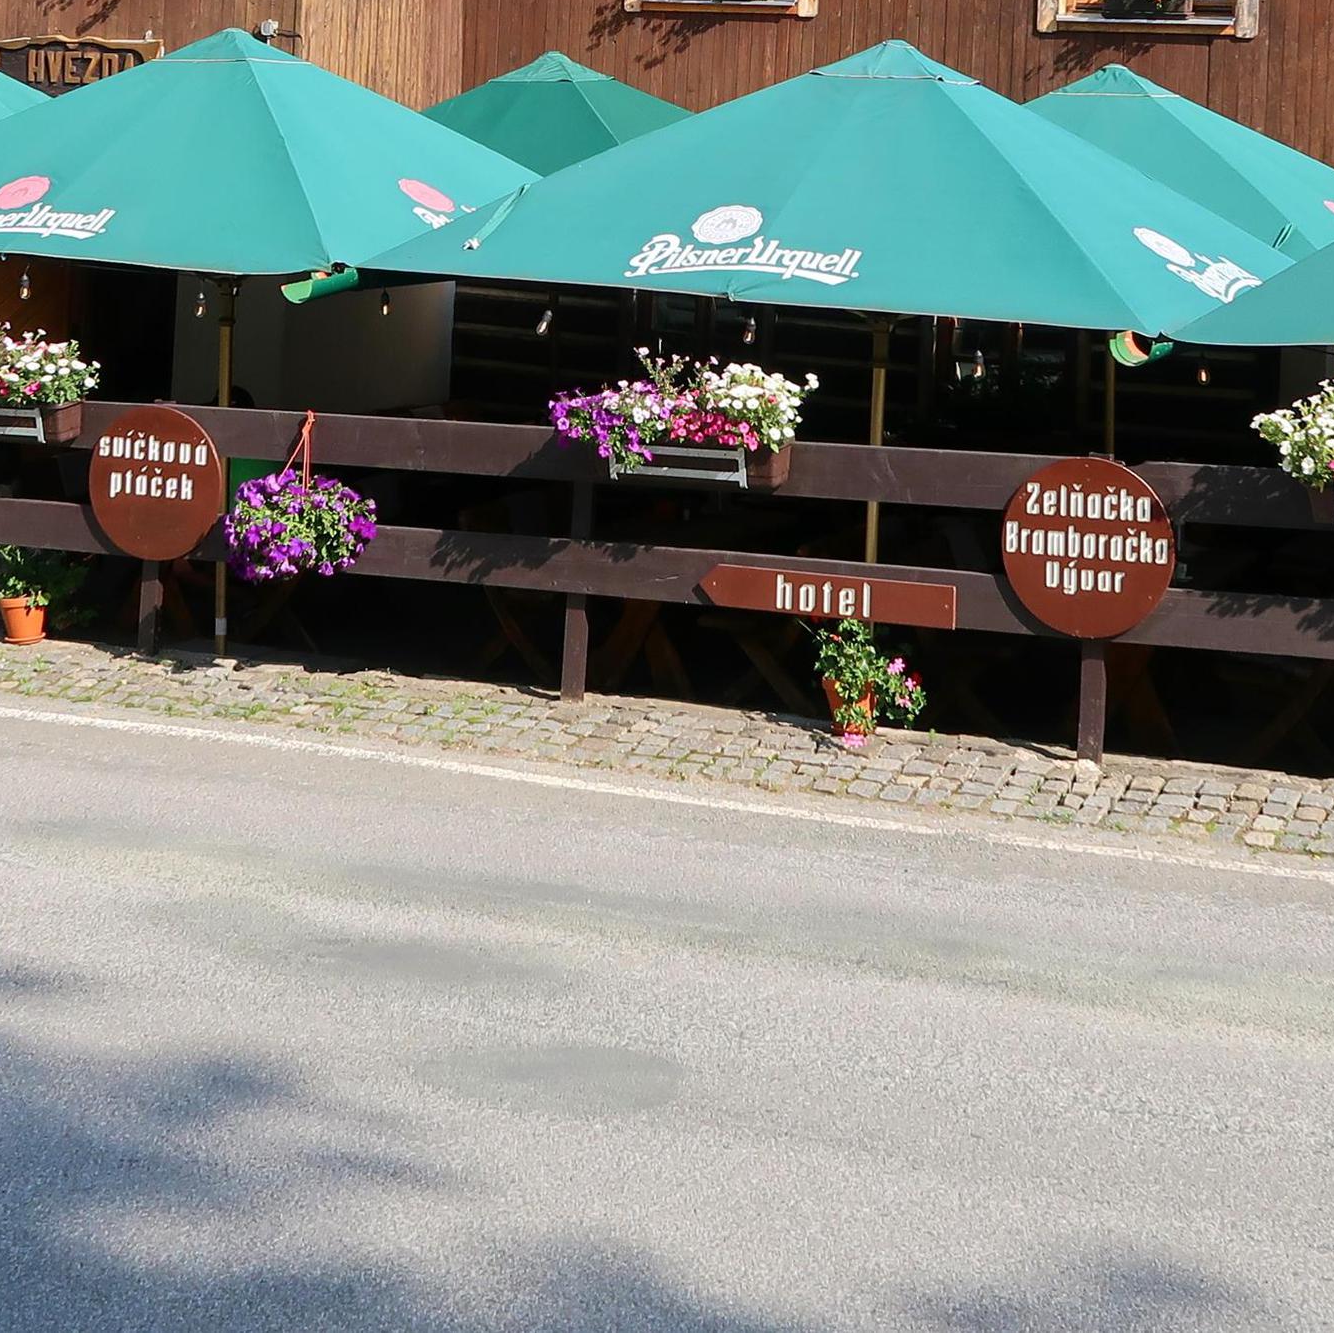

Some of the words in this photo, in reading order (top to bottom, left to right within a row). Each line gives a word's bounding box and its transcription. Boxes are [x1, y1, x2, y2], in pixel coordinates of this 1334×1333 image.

[623, 234, 754, 277] Pilsner
[98, 429, 208, 466] svíčková
[109, 465, 194, 500] ptáček
[1026, 481, 1152, 523] Zelňačka
[1005, 520, 1169, 565] Bramboračka
[775, 573, 871, 618] hotel
[1045, 560, 1126, 596] Vývar
